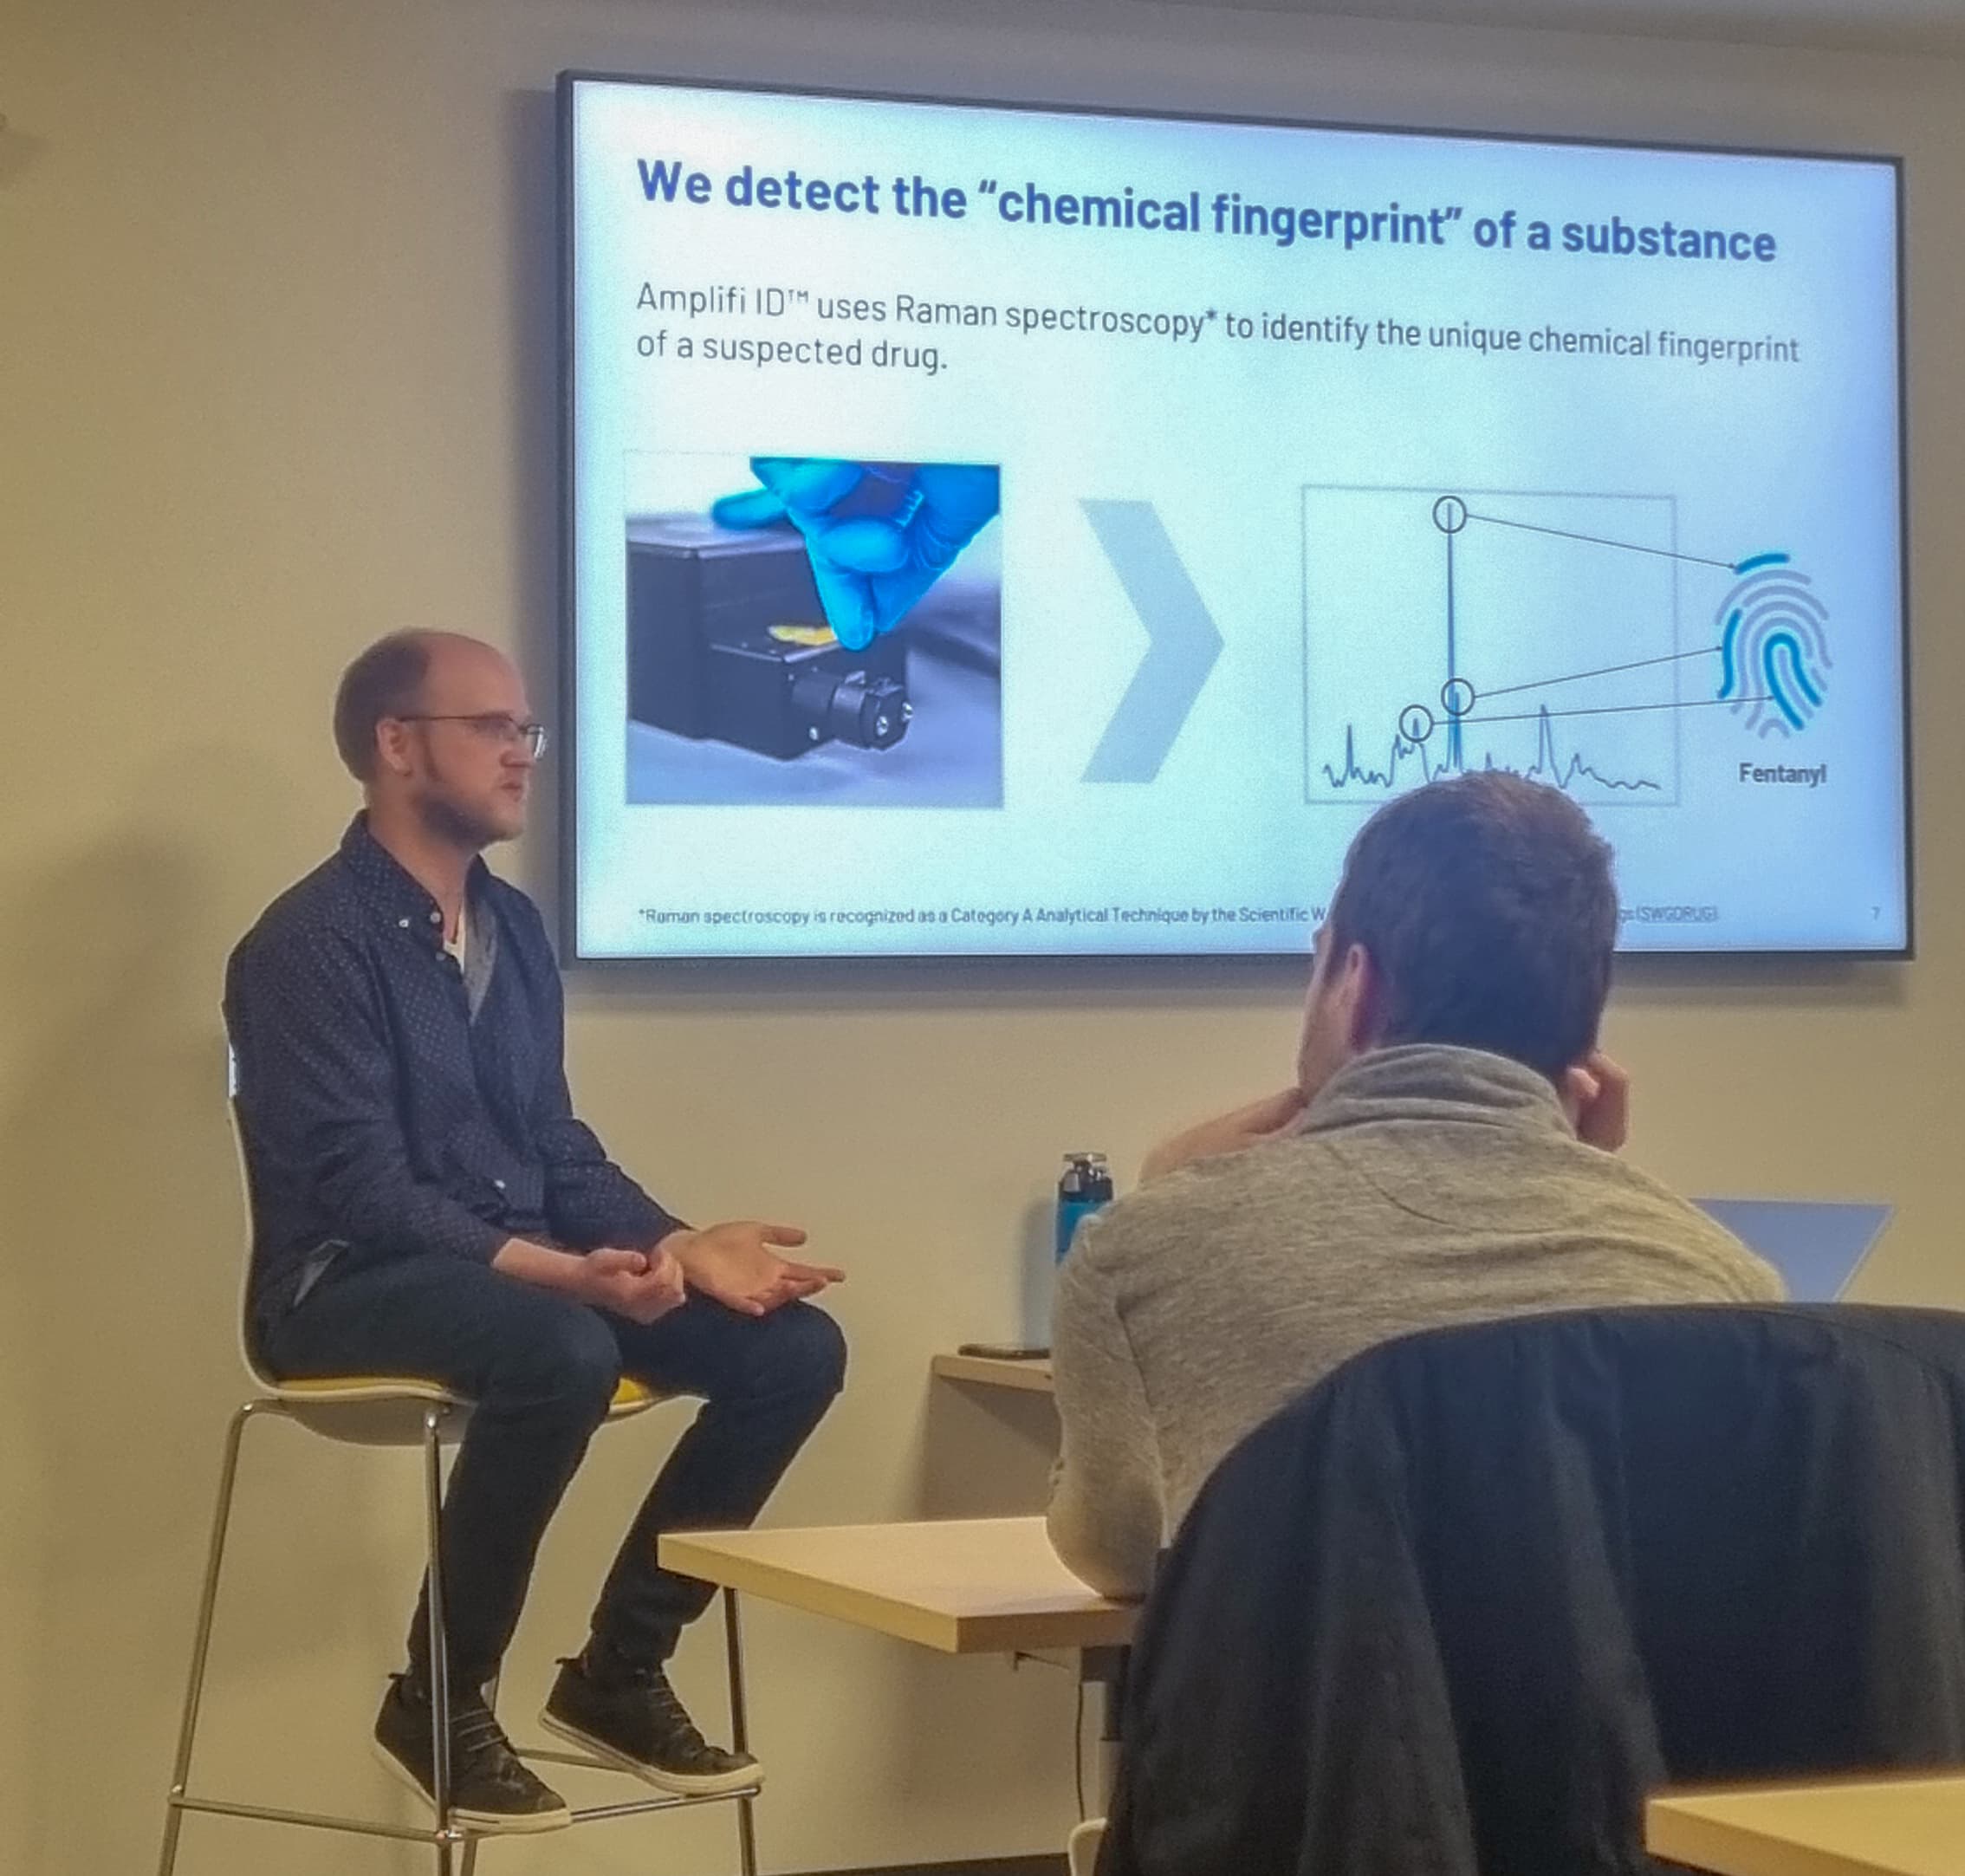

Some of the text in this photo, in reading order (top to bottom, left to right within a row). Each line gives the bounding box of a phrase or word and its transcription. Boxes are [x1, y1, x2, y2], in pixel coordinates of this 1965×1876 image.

[637, 159, 712, 204] We
[726, 166, 880, 214] detect
[893, 176, 967, 218] the
[1474, 211, 1516, 250] of
[1527, 219, 1551, 251] a
[1562, 216, 1777, 262] substance
[637, 282, 745, 318] Amplifi
[817, 297, 886, 323] uses
[896, 295, 997, 327] Raman
[1226, 313, 1253, 339] to
[1261, 312, 1369, 349] identify
[1377, 319, 1421, 346] the
[1430, 321, 1521, 355] unique
[1529, 326, 1650, 356] chemical
[1658, 330, 1800, 366] fingerprint
[637, 330, 948, 376] of a suspected drug.
[1740, 763, 1826, 788] Fentanyl
[704, 909, 809, 925] spectroscopy
[814, 909, 827, 923] is
[830, 909, 914, 925] recognized
[918, 911, 935, 923] as
[938, 912, 947, 923] a
[952, 909, 1018, 925] Category
[1023, 909, 1033, 922] A
[1038, 908, 1108, 925] Analytical
[1112, 908, 1188, 925] Technique
[1192, 908, 1209, 925] by
[1213, 908, 1235, 922] the
[1239, 907, 1308, 922] Scientific
